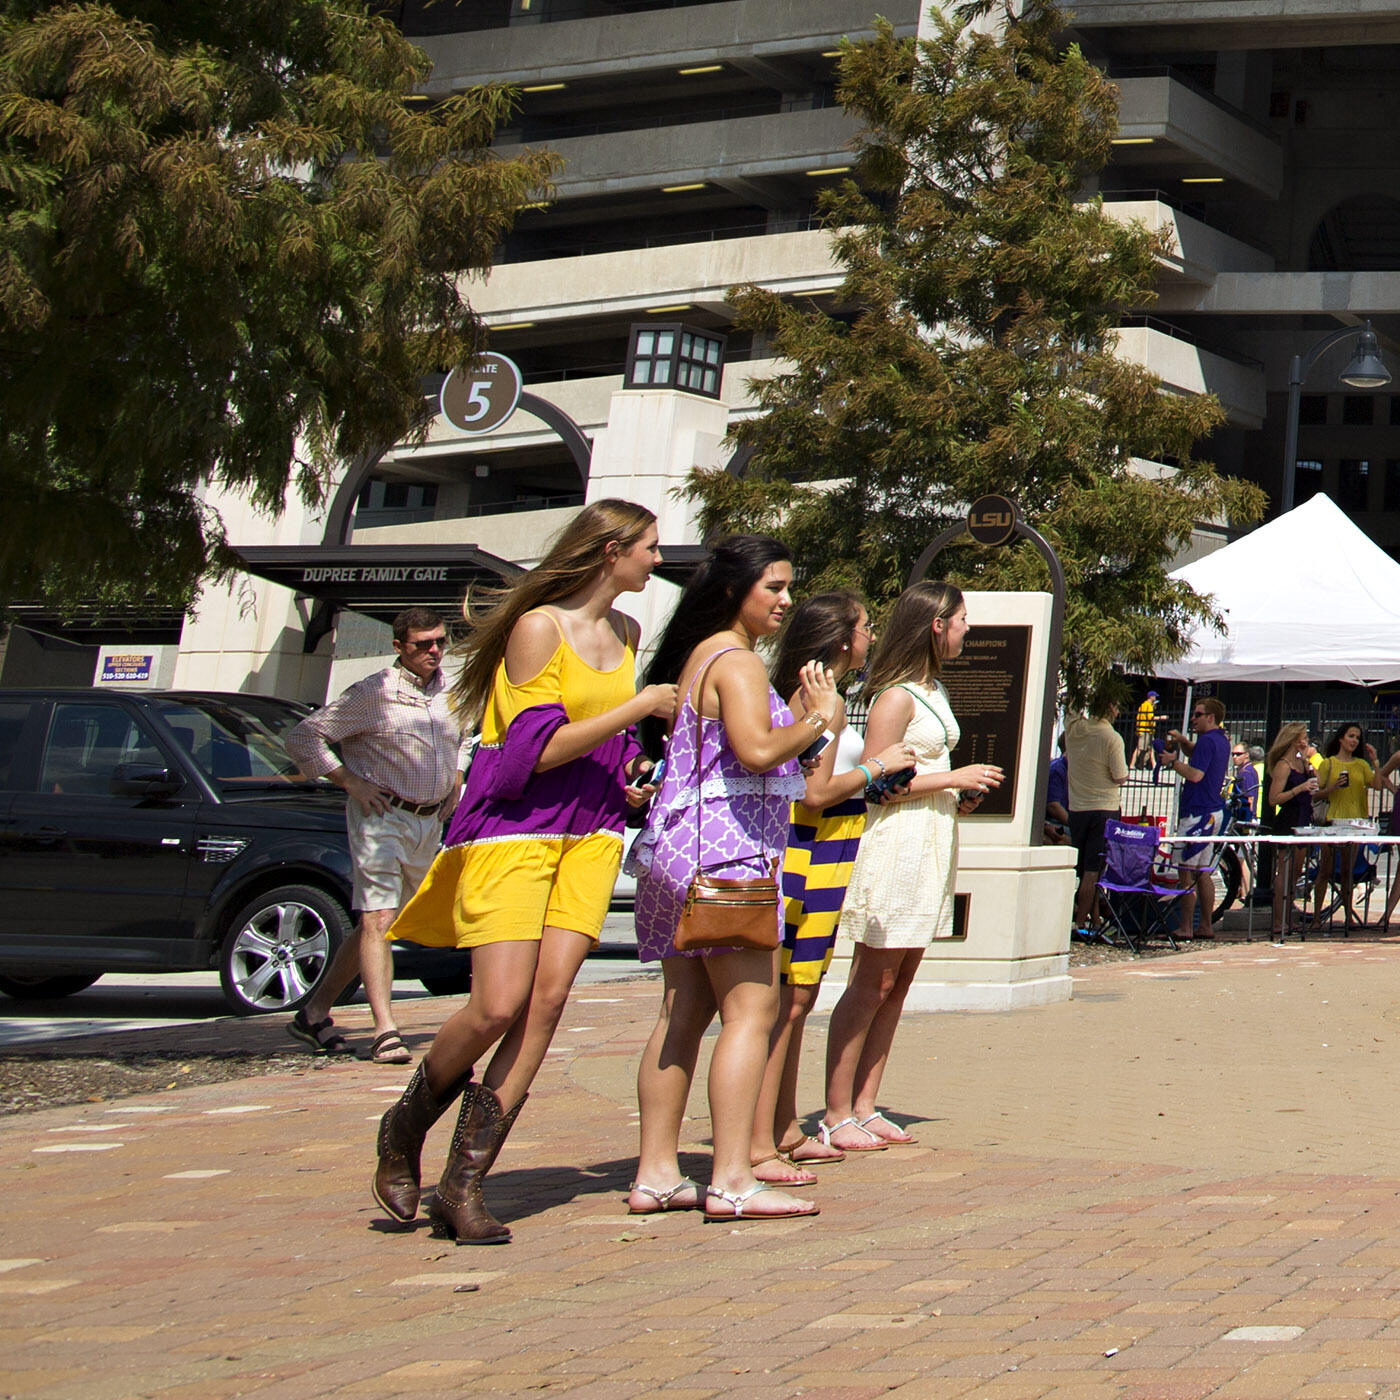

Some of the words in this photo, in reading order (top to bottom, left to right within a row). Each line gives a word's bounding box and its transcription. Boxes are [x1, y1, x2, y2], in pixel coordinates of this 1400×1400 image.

[464, 380, 493, 422] 5
[971, 512, 1011, 528] LSU
[303, 567, 356, 583] DUPREE
[361, 567, 411, 582] FAMILY
[413, 567, 449, 581] GATE
[964, 639, 1008, 648] CHAMPIONS
